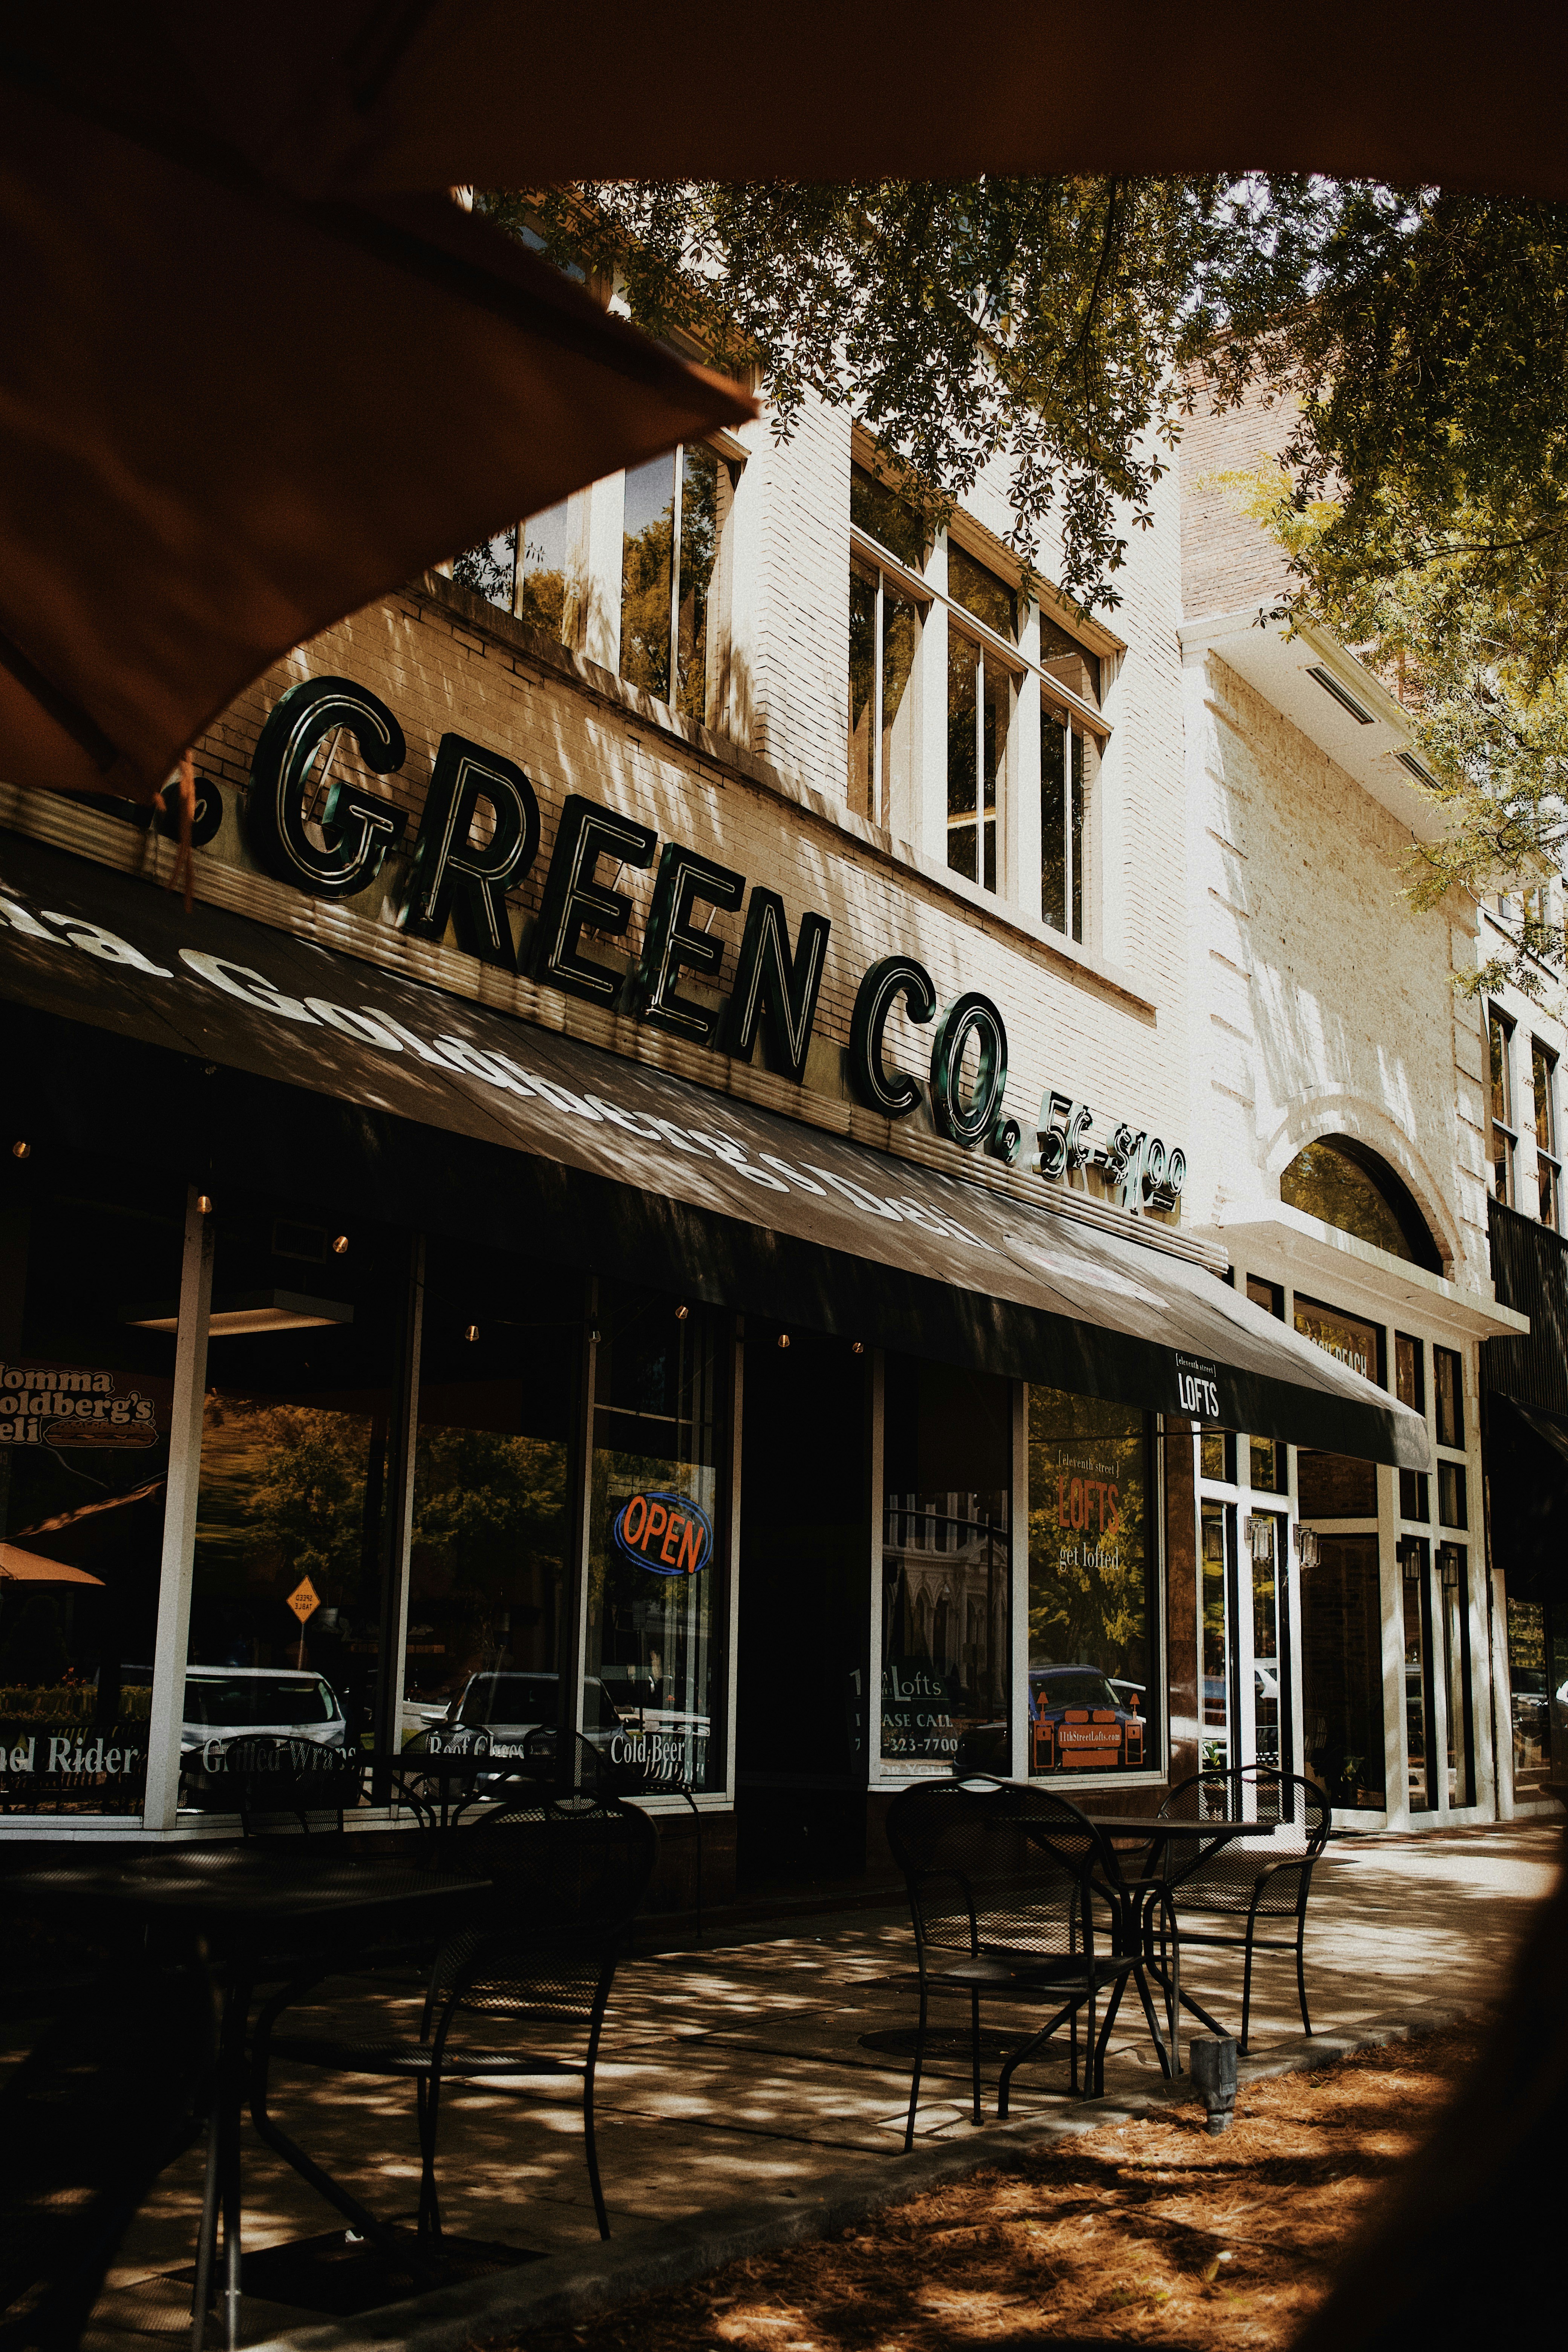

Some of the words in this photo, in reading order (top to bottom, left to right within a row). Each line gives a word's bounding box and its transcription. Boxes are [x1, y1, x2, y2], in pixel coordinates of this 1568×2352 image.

[249, 675, 831, 1083] GREEN
[848, 956, 1021, 1164] CO.
[178, 948, 827, 1196] Goldberg's
[796, 1161, 1007, 1256] Deli
[0, 1364, 111, 1392] omma
[1178, 1372, 1219, 1417] LOFTS
[1059, 1475, 1119, 1534] LOFTS
[623, 1495, 704, 1574] OPEN
[1059, 1546, 1079, 1572] get
[1083, 1542, 1118, 1570] lofted
[891, 1665, 942, 1701] Lofts
[916, 1714, 953, 1727] CALL
[1060, 1730, 1120, 1742] 11thStreetLofts.com
[45, 1737, 139, 1773] Rider
[611, 1734, 646, 1764] Cold
[651, 1735, 685, 1763] Beer
